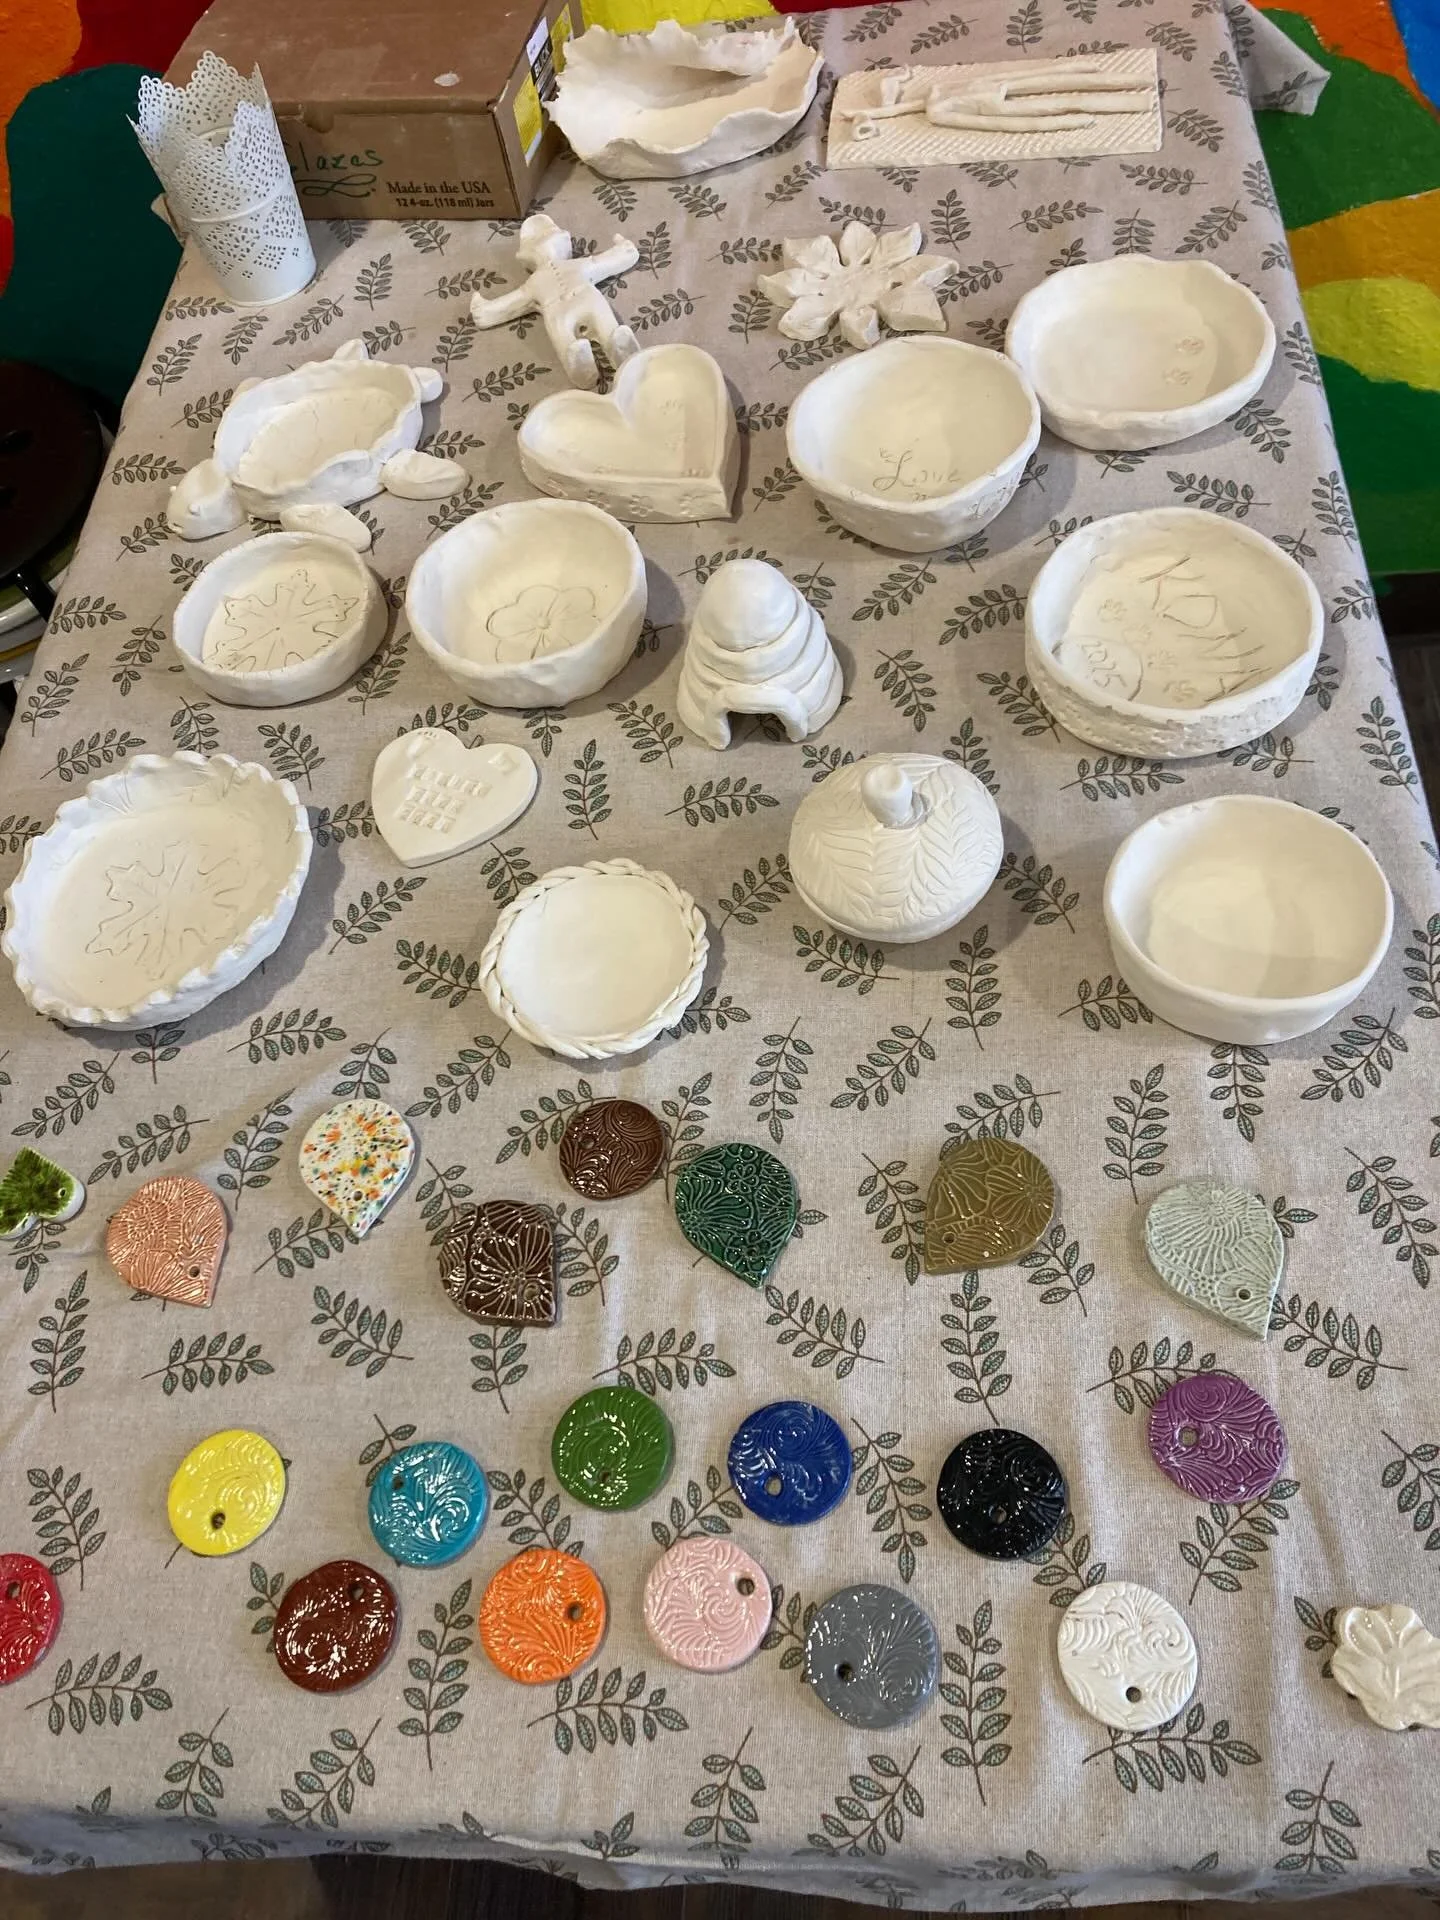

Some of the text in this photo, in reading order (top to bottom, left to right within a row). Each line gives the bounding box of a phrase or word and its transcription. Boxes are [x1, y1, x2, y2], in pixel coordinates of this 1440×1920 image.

[386, 181, 492, 194] Made in the USA
